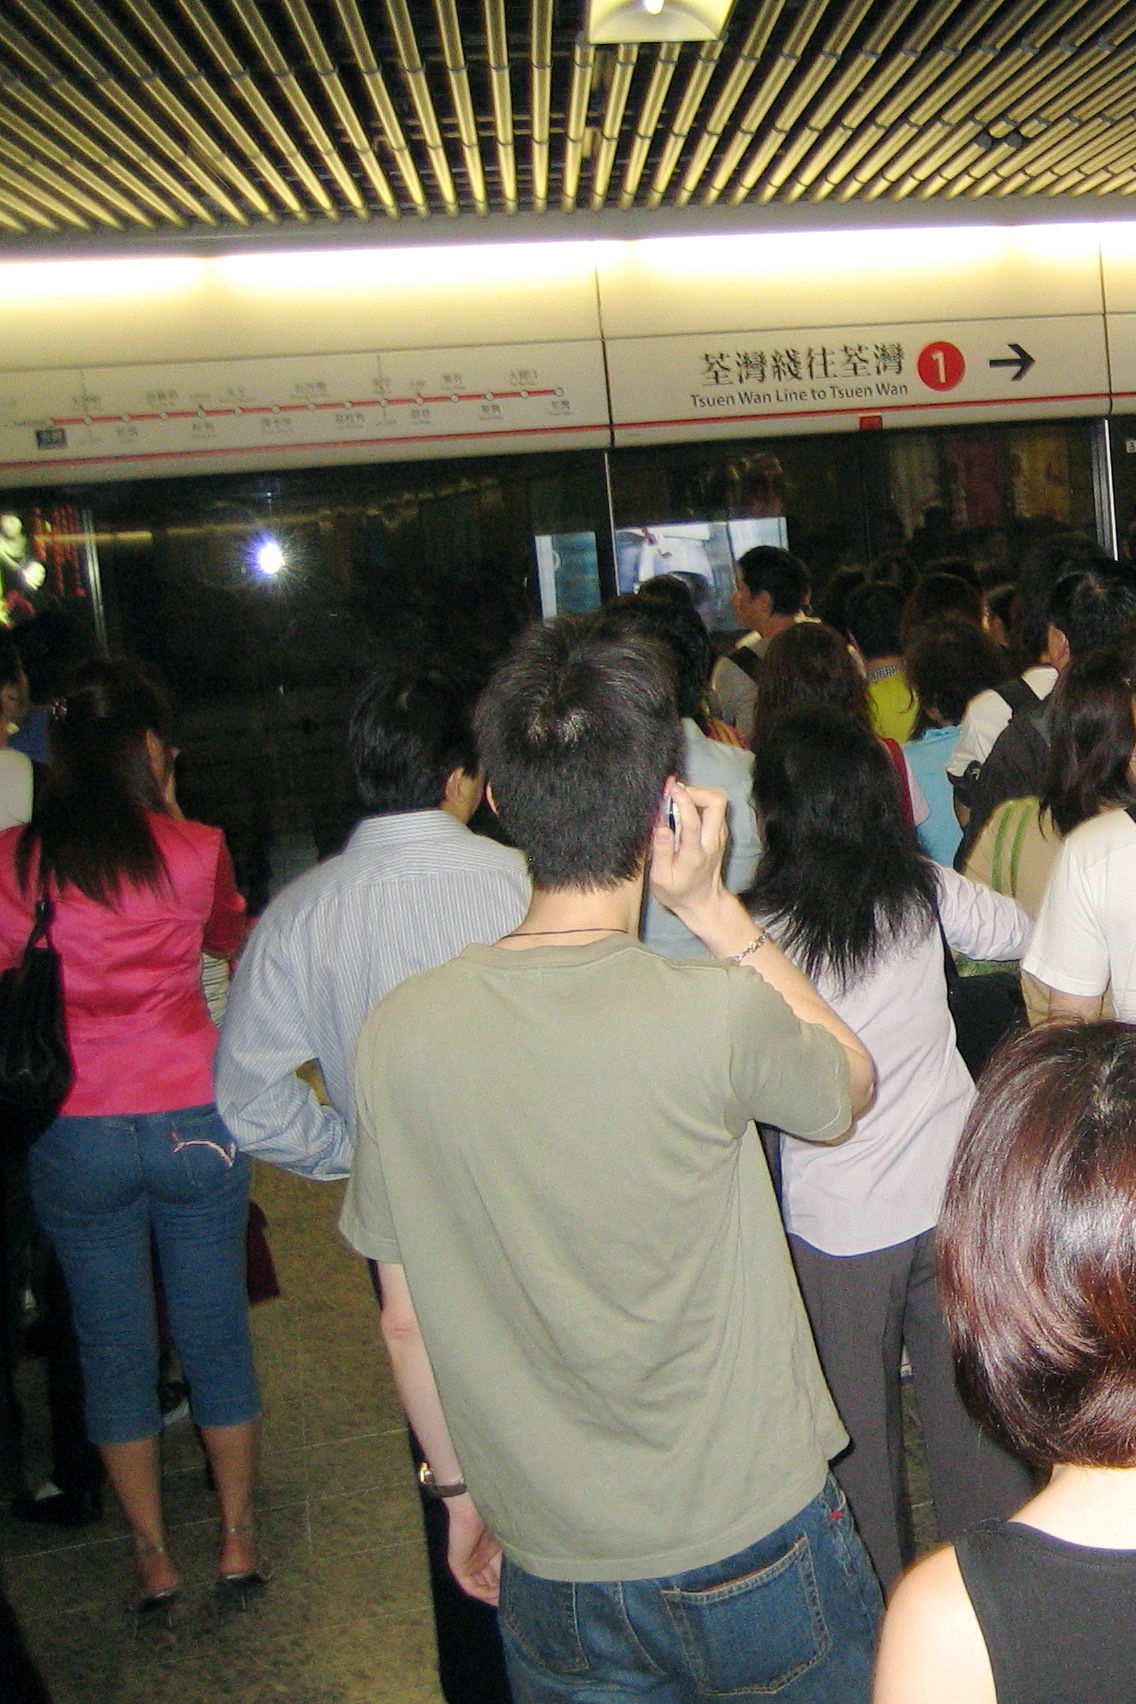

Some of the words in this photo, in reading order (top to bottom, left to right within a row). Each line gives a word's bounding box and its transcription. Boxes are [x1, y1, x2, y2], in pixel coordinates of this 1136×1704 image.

[930, 350, 947, 384] 1
[691, 393, 735, 408] Tsuen
[739, 391, 772, 405] Wan
[776, 388, 808, 402] Line
[811, 388, 826, 400] to
[829, 384, 874, 399] Tsuen
[876, 382, 908, 396] Wan
